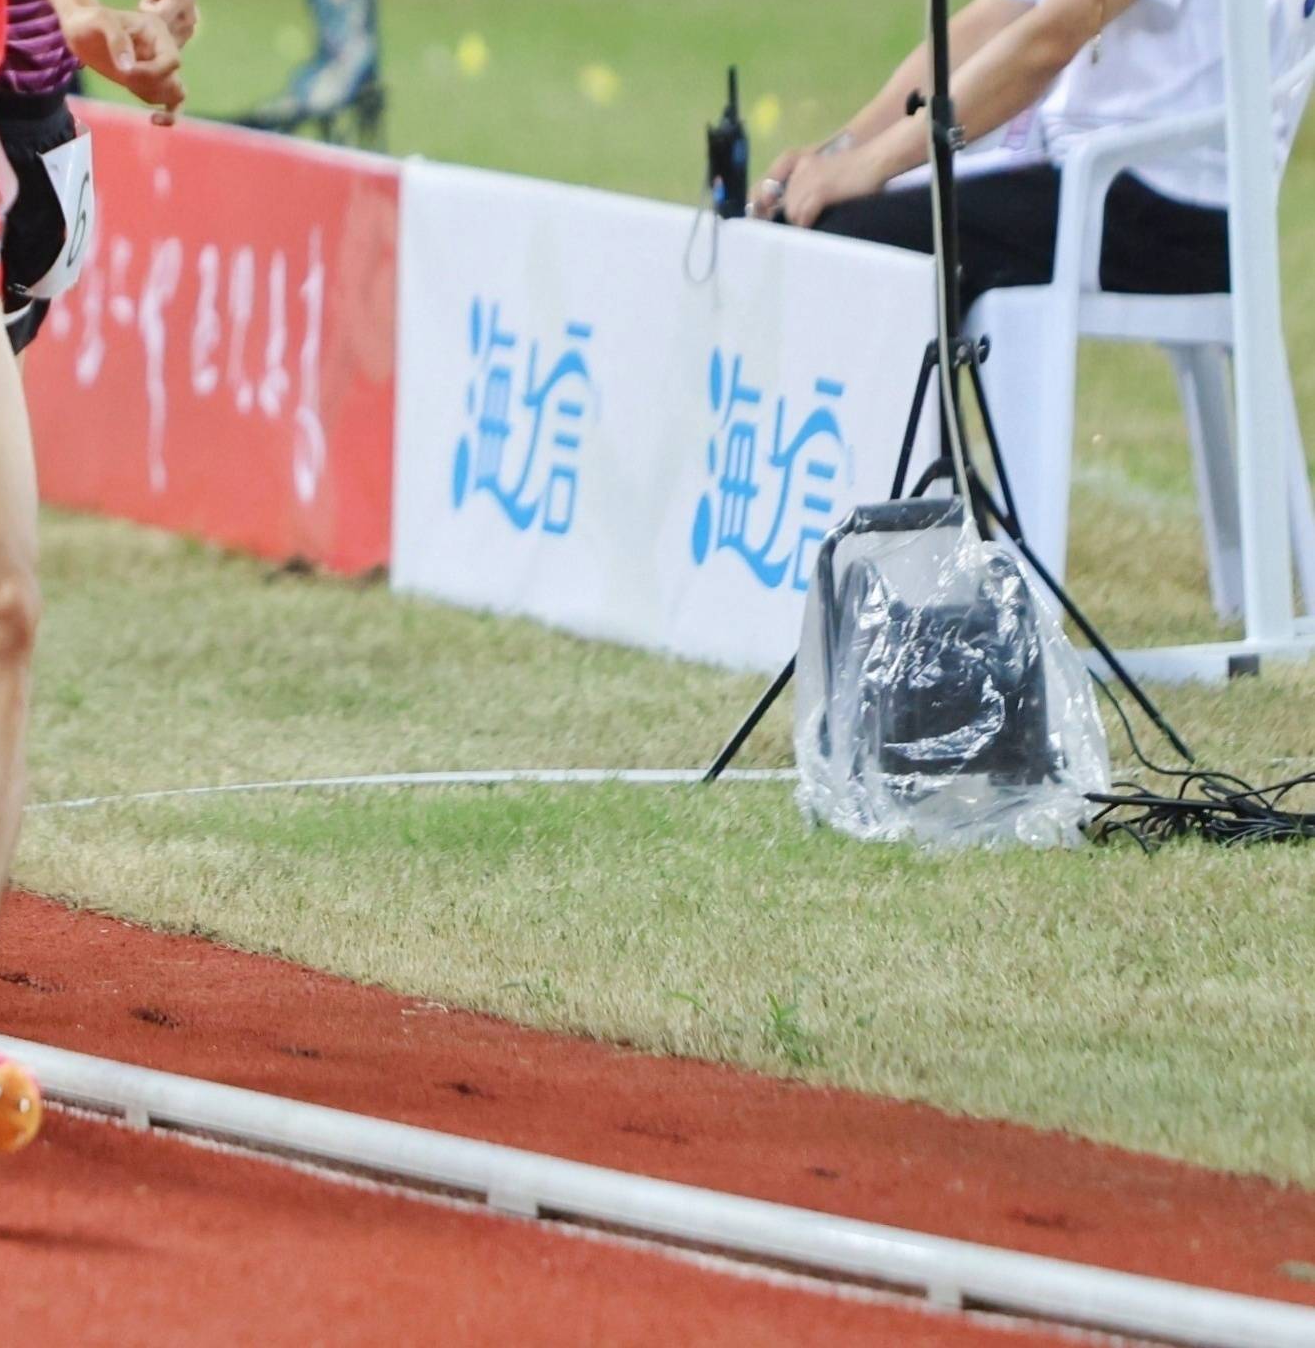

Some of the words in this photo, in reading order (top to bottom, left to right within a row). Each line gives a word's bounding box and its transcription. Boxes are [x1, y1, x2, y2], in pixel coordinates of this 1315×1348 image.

[66, 171, 90, 268] 6
[454, 296, 593, 534] 海信
[692, 345, 845, 591] 海信
